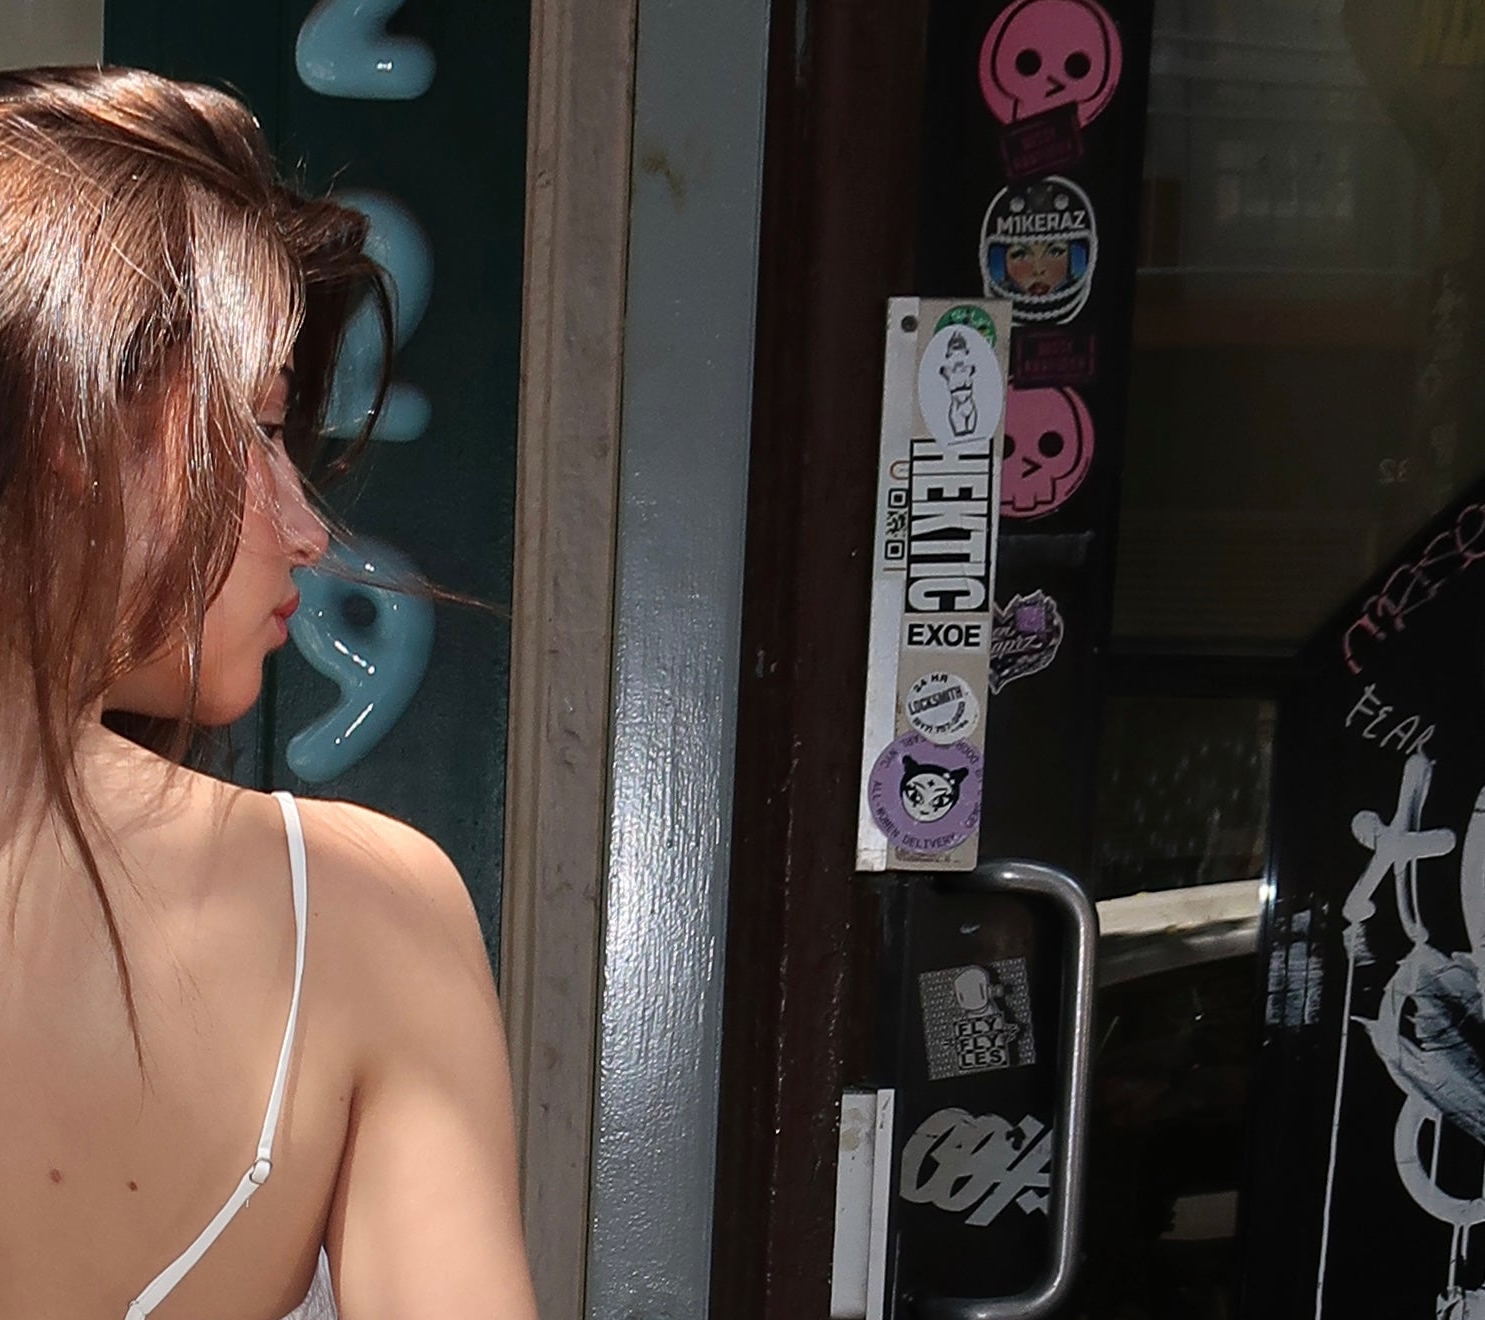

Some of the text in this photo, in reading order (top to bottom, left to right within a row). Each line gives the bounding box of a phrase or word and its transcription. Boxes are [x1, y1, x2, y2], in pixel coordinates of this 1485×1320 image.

[996, 210, 1086, 235] M1KERAZ
[908, 442, 989, 611] HEKTIC
[908, 624, 981, 647] EXOE
[908, 685, 963, 715] LOCKSMITH
[1345, 682, 1435, 755] FEAR
[959, 1018, 996, 1036] FLY
[960, 1034, 997, 1051] FLY
[962, 1050, 1002, 1066] LES
